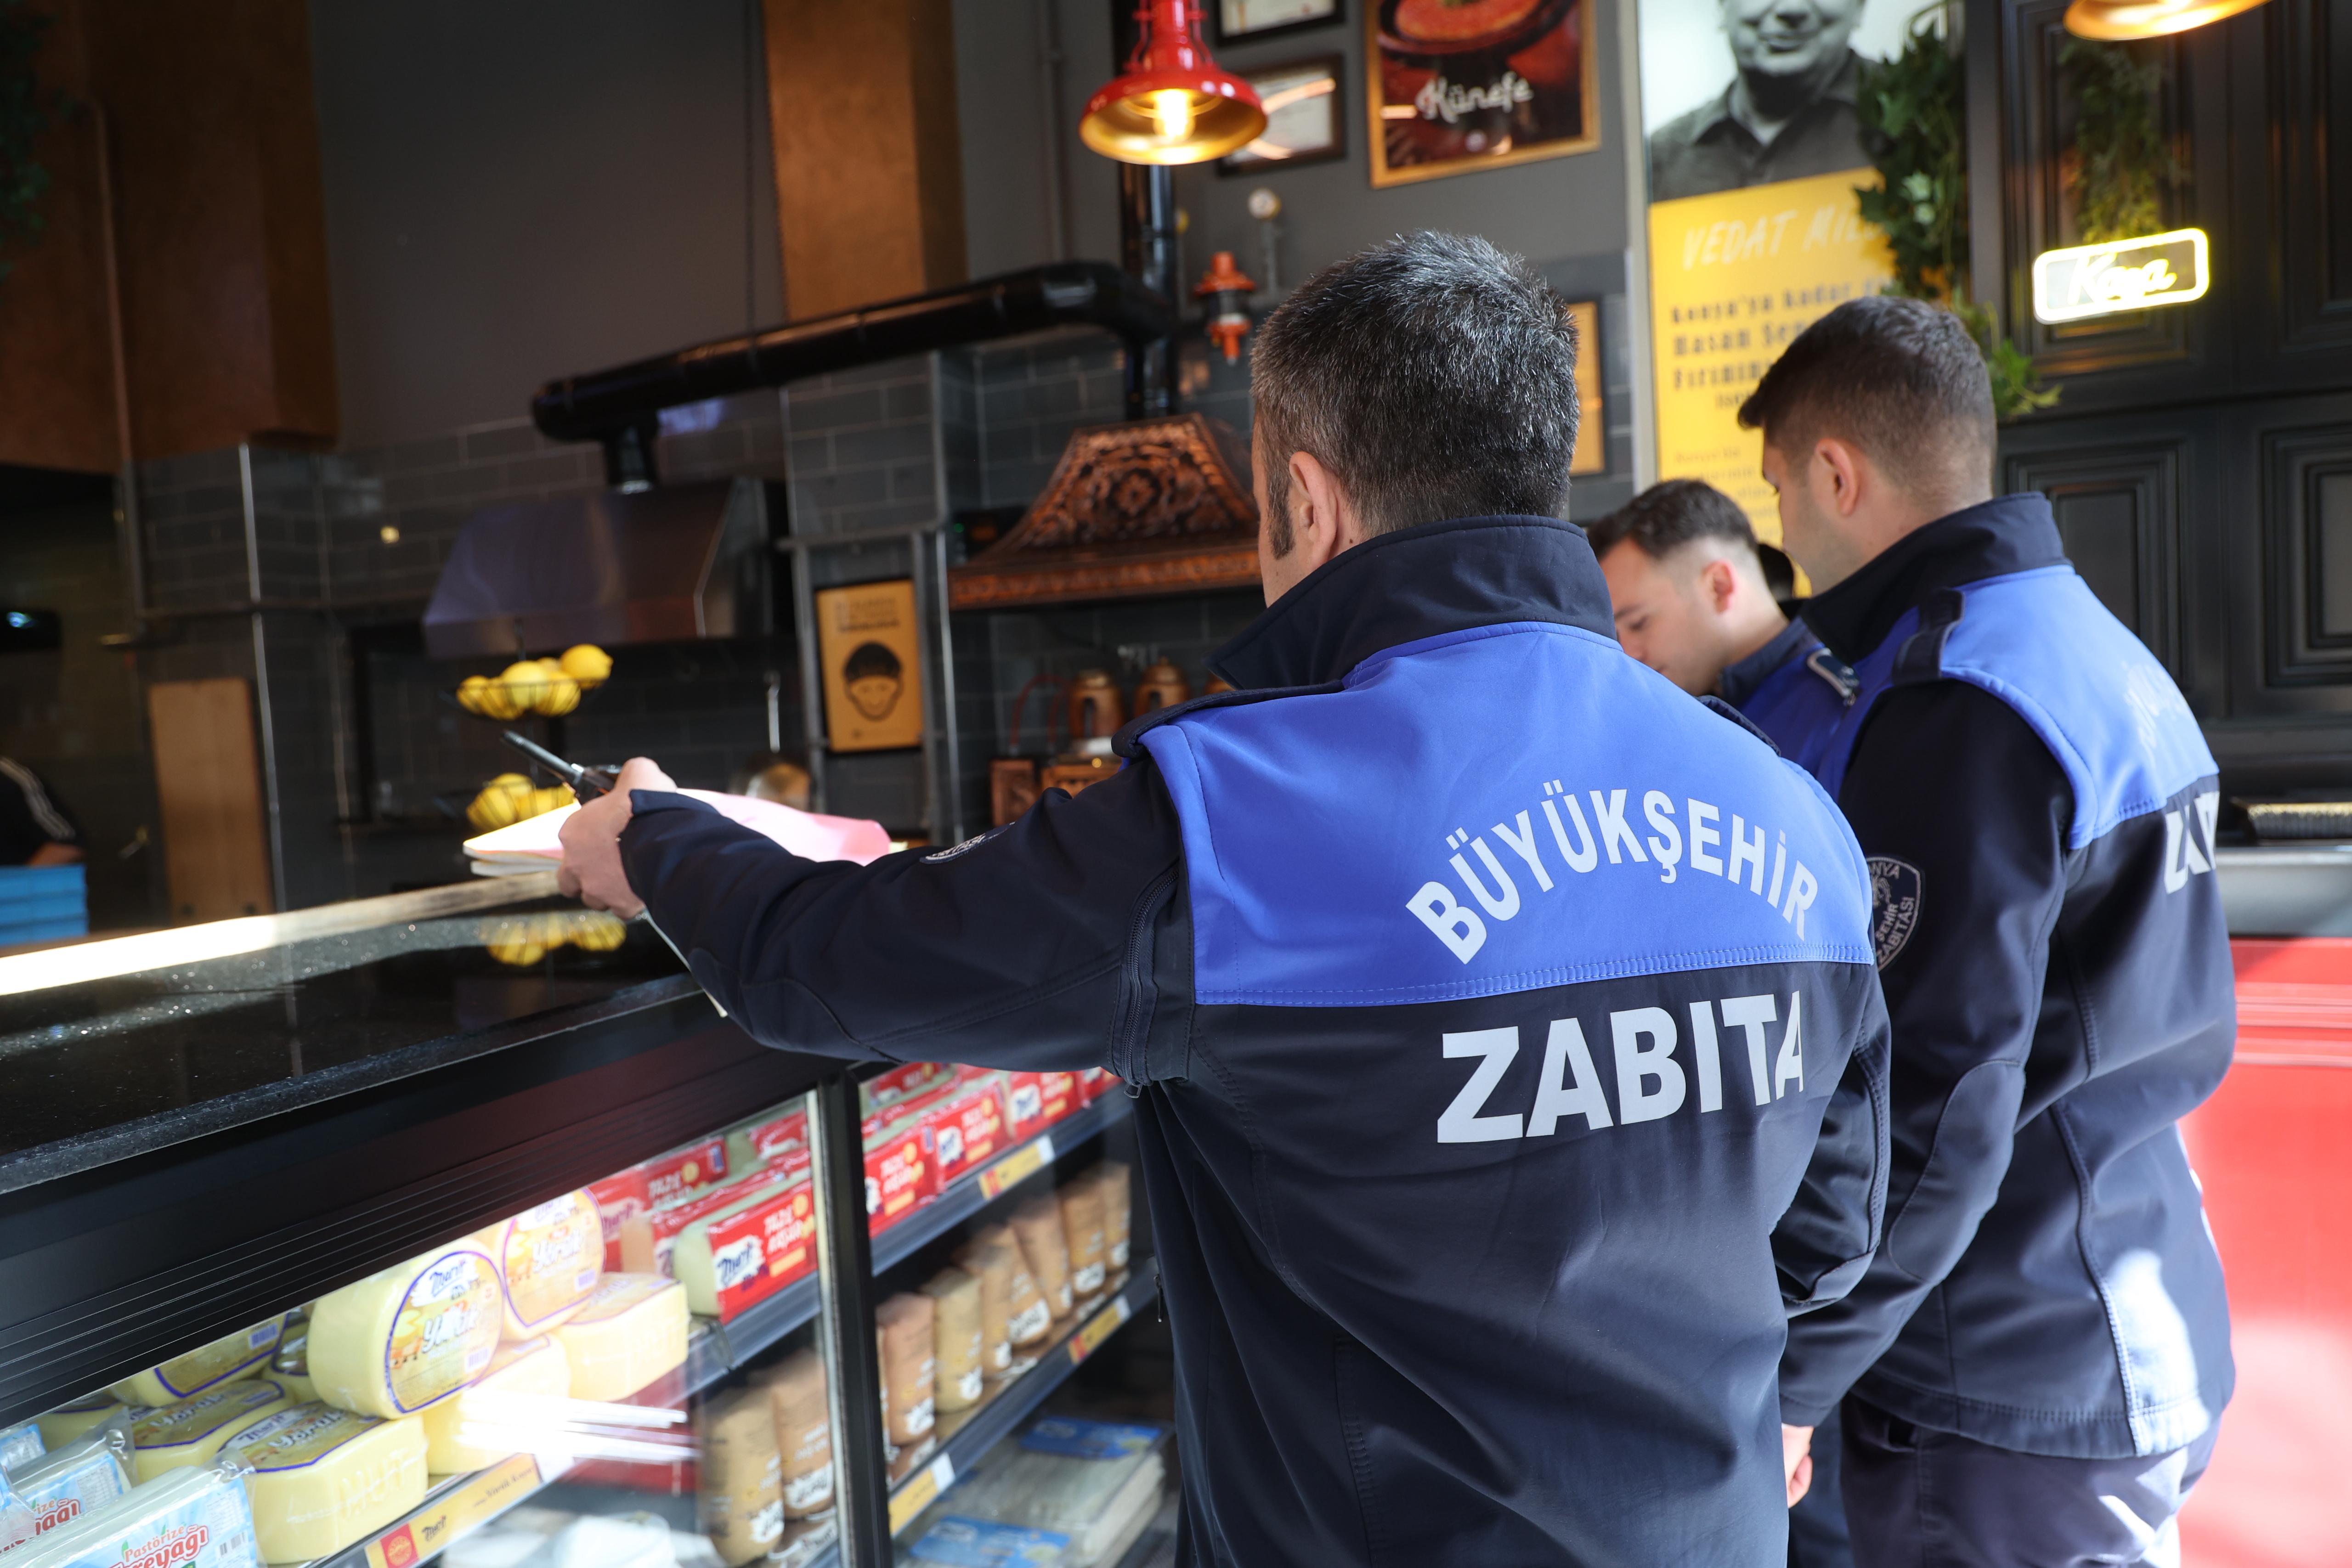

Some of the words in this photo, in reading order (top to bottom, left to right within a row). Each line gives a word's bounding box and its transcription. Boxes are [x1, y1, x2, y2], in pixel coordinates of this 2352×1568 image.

[1415, 71, 1534, 124] Künefe
[1683, 209, 1798, 271] VEDAT
[1406, 779, 1819, 965] BÜYÜKŞEHİR
[1436, 990, 1804, 1143] ZABITA
[124, 1525, 185, 1562] Pastörize
